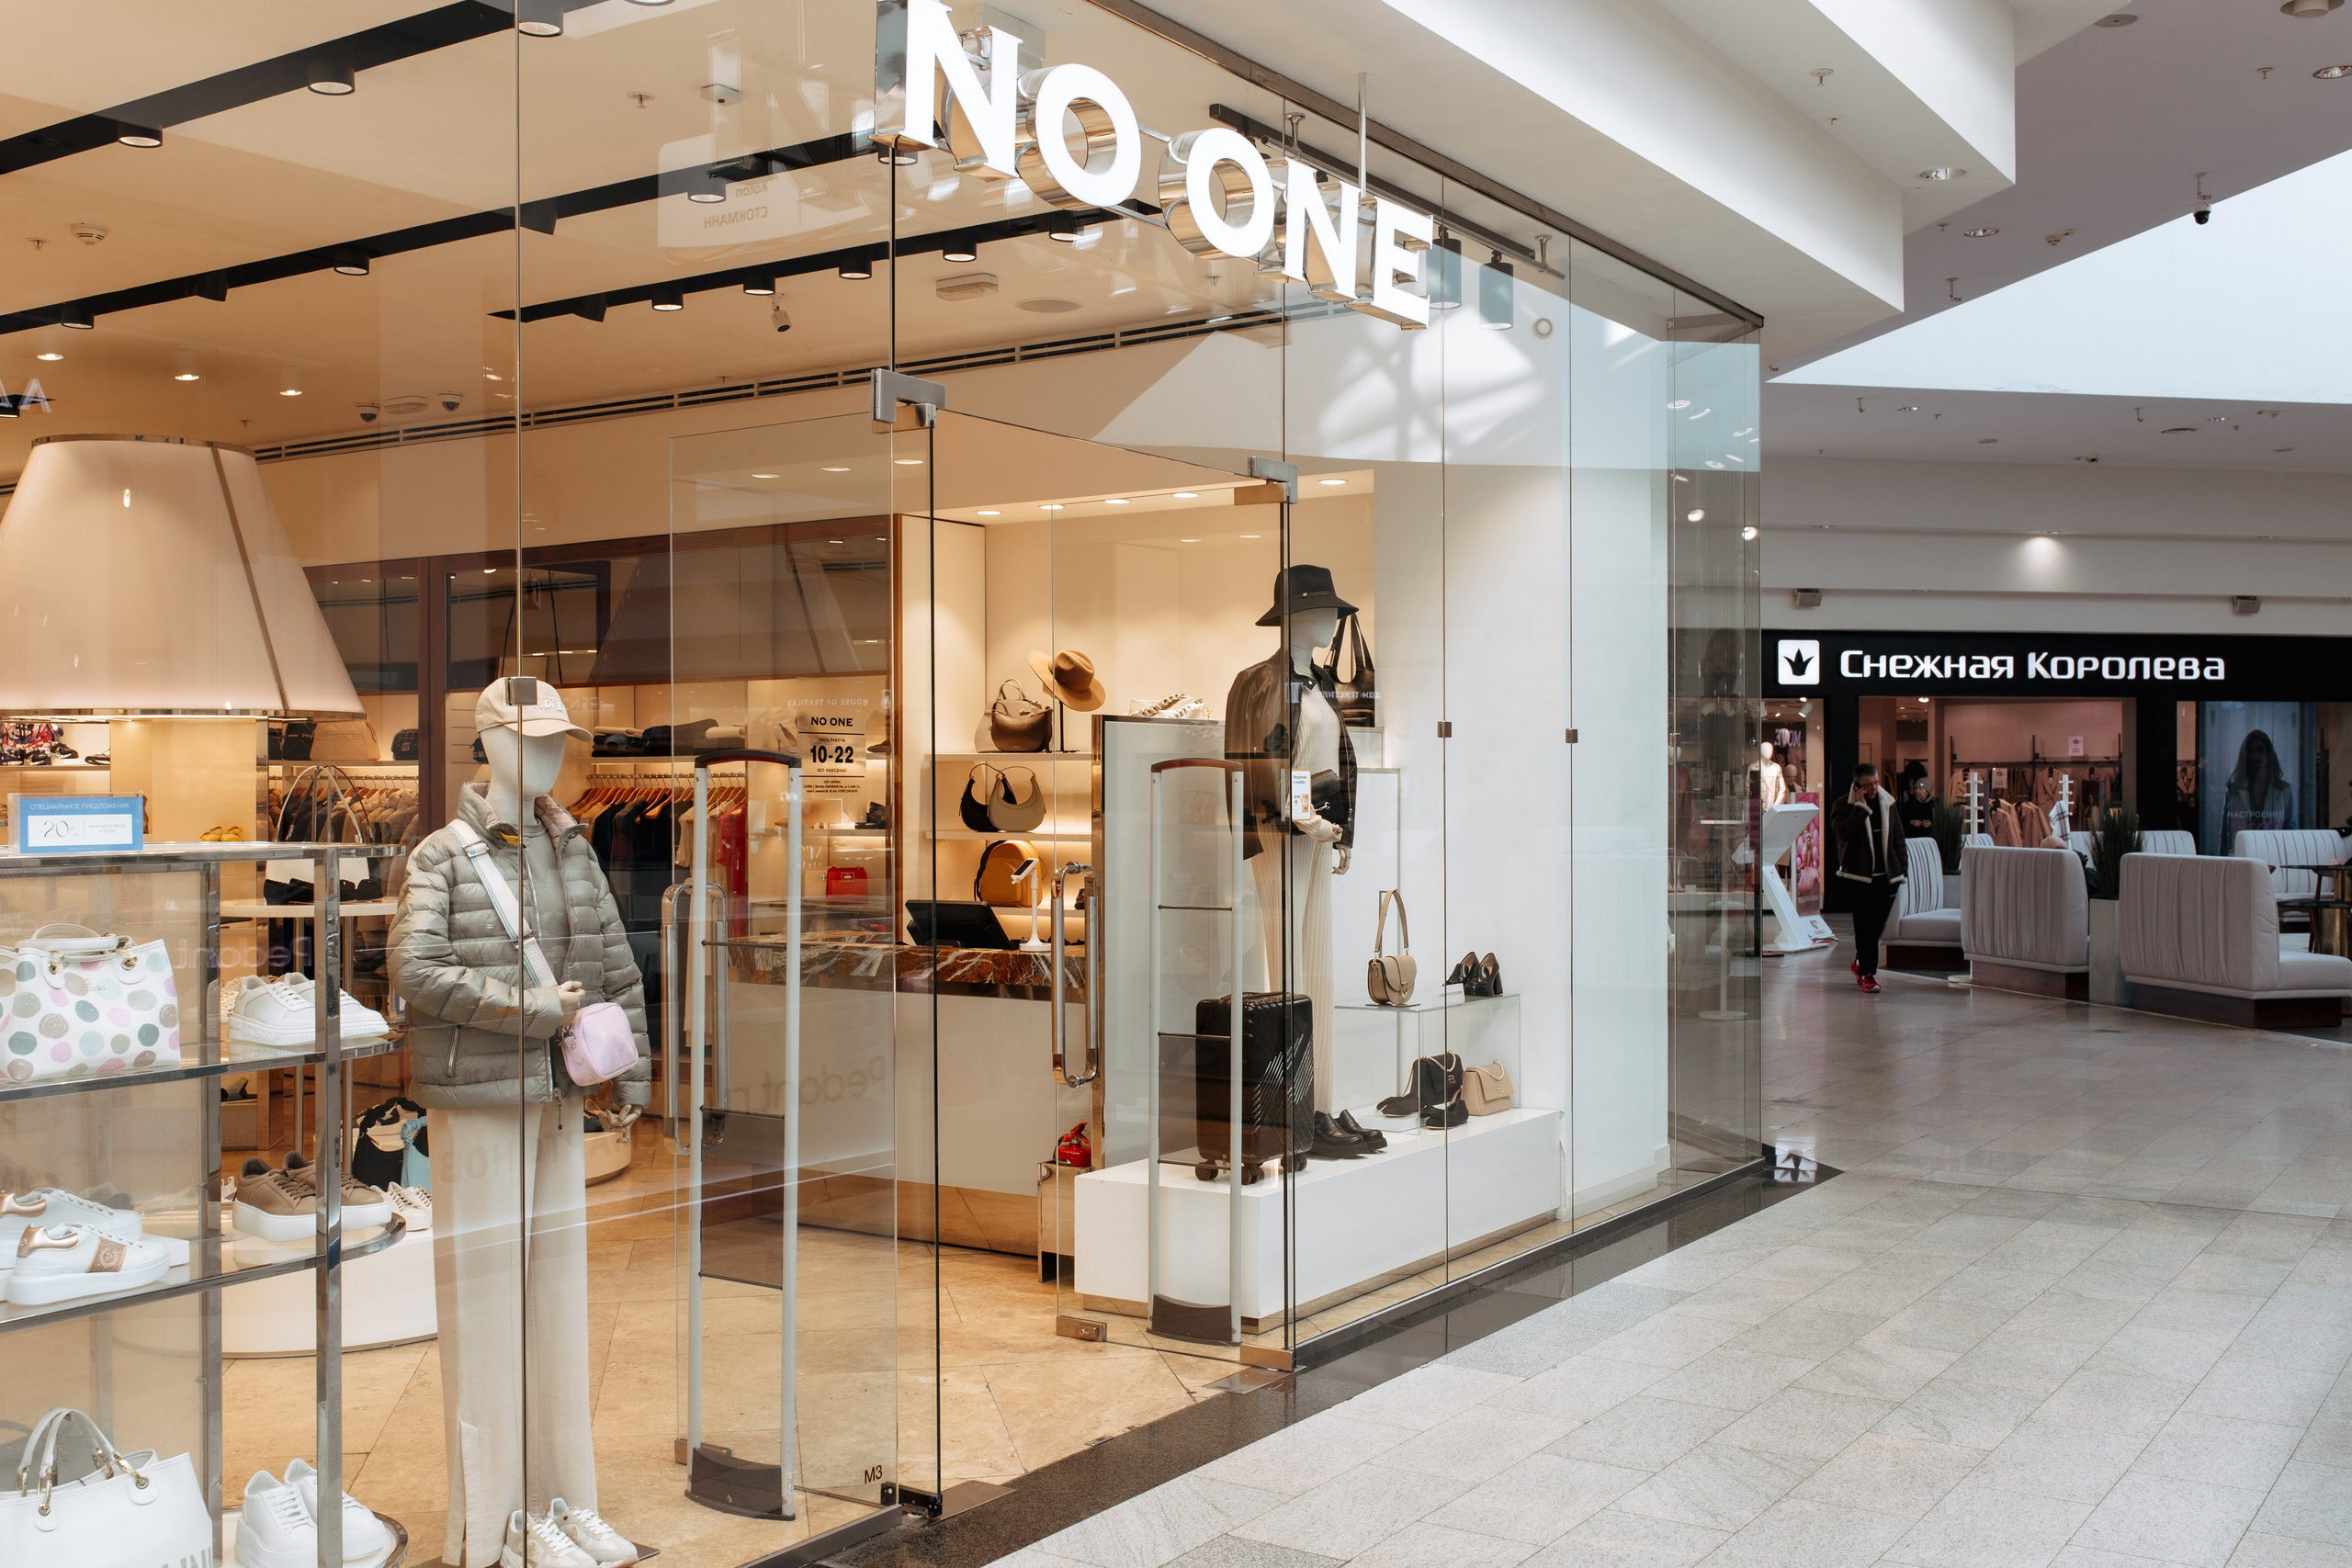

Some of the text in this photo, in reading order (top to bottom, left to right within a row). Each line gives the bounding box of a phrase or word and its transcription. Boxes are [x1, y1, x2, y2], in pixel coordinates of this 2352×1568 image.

[899, 0, 1434, 329] NO ONE
[2027, 652, 2225, 680] Королева
[810, 716, 854, 727] NO ONE
[809, 745, 854, 764] 10-22
[2227, 810, 2284, 818] НАСТРОЕНИЕ
[864, 1464, 883, 1484] M3
